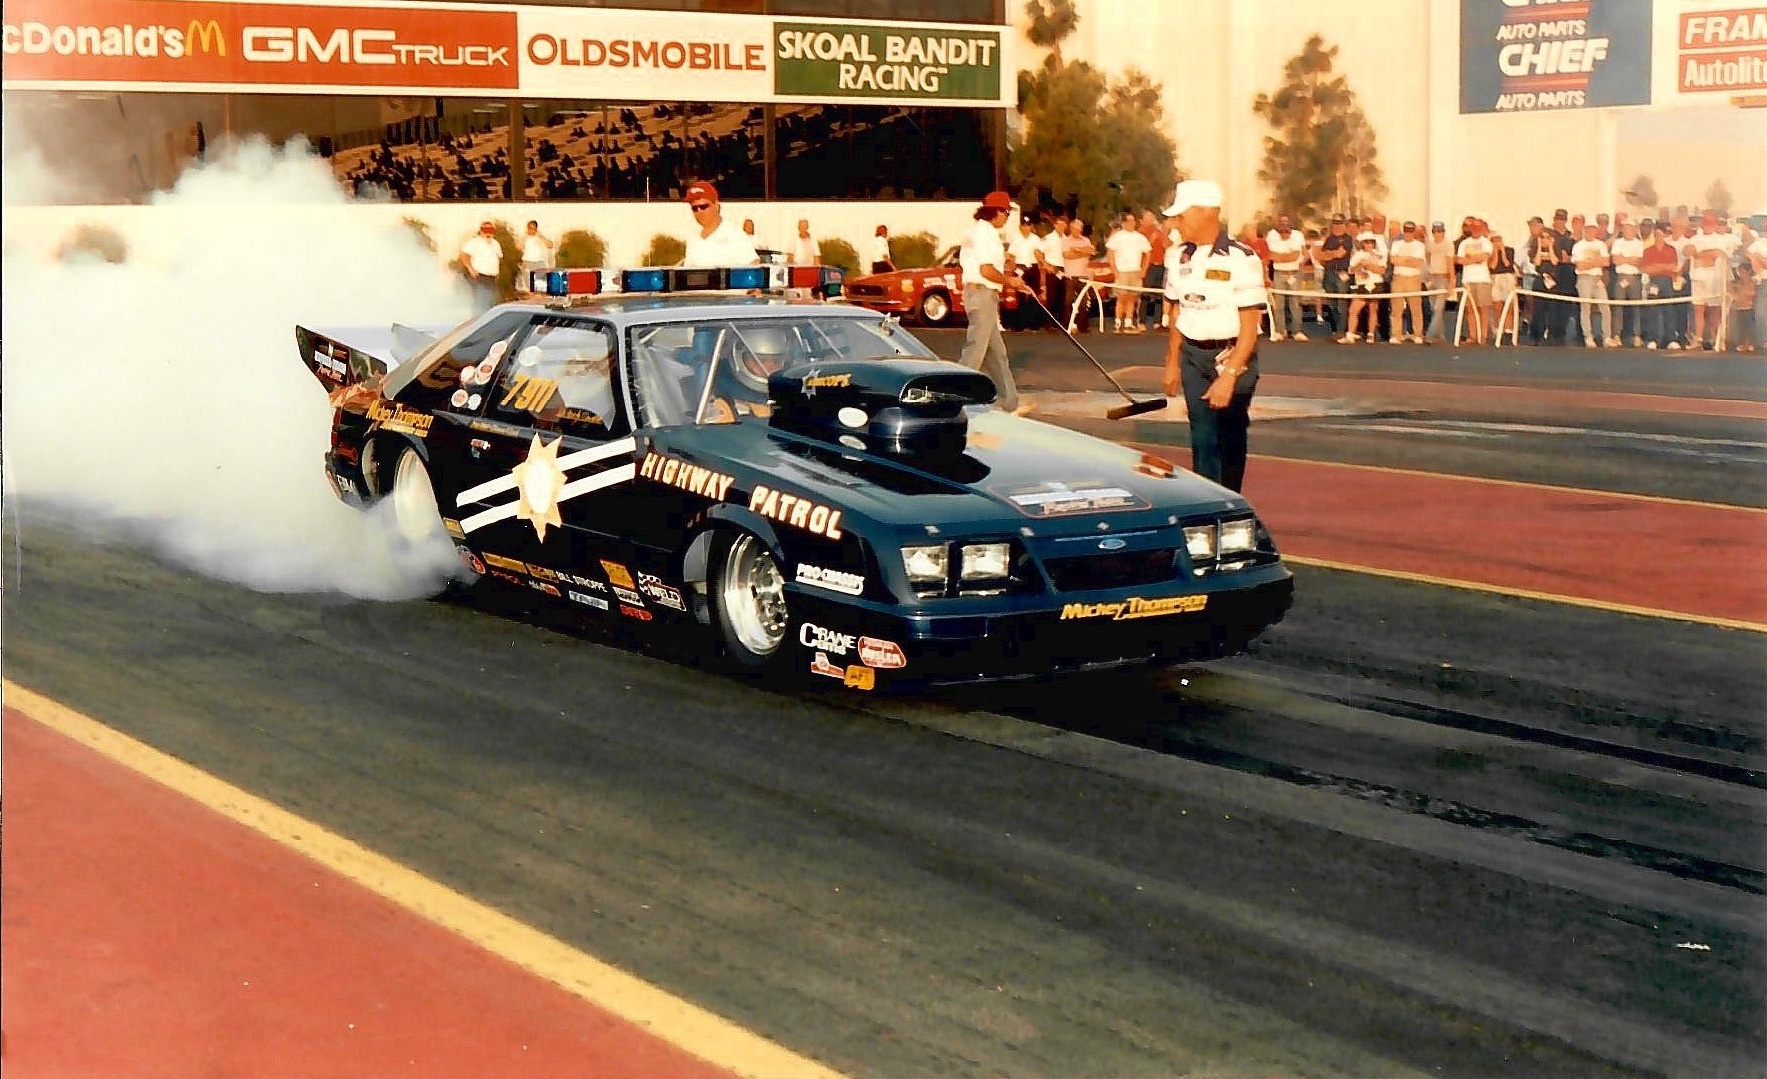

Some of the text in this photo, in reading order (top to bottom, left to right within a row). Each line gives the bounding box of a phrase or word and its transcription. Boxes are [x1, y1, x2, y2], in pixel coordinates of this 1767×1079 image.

[242, 26, 509, 66] GMC TRUCK
[1496, 20, 1586, 40] AUTO PARTS
[527, 33, 767, 71] OLDSMOBILE
[778, 31, 996, 66] SKOAL BANDIT
[1499, 38, 1609, 76] CHIEF
[838, 63, 940, 92] RACING
[1496, 90, 1586, 110] AUTO PARTS
[640, 452, 844, 540] HIGHWAY PATROL
[1060, 595, 1209, 621] Mickey Thompson
[800, 622, 857, 650] CRANE
